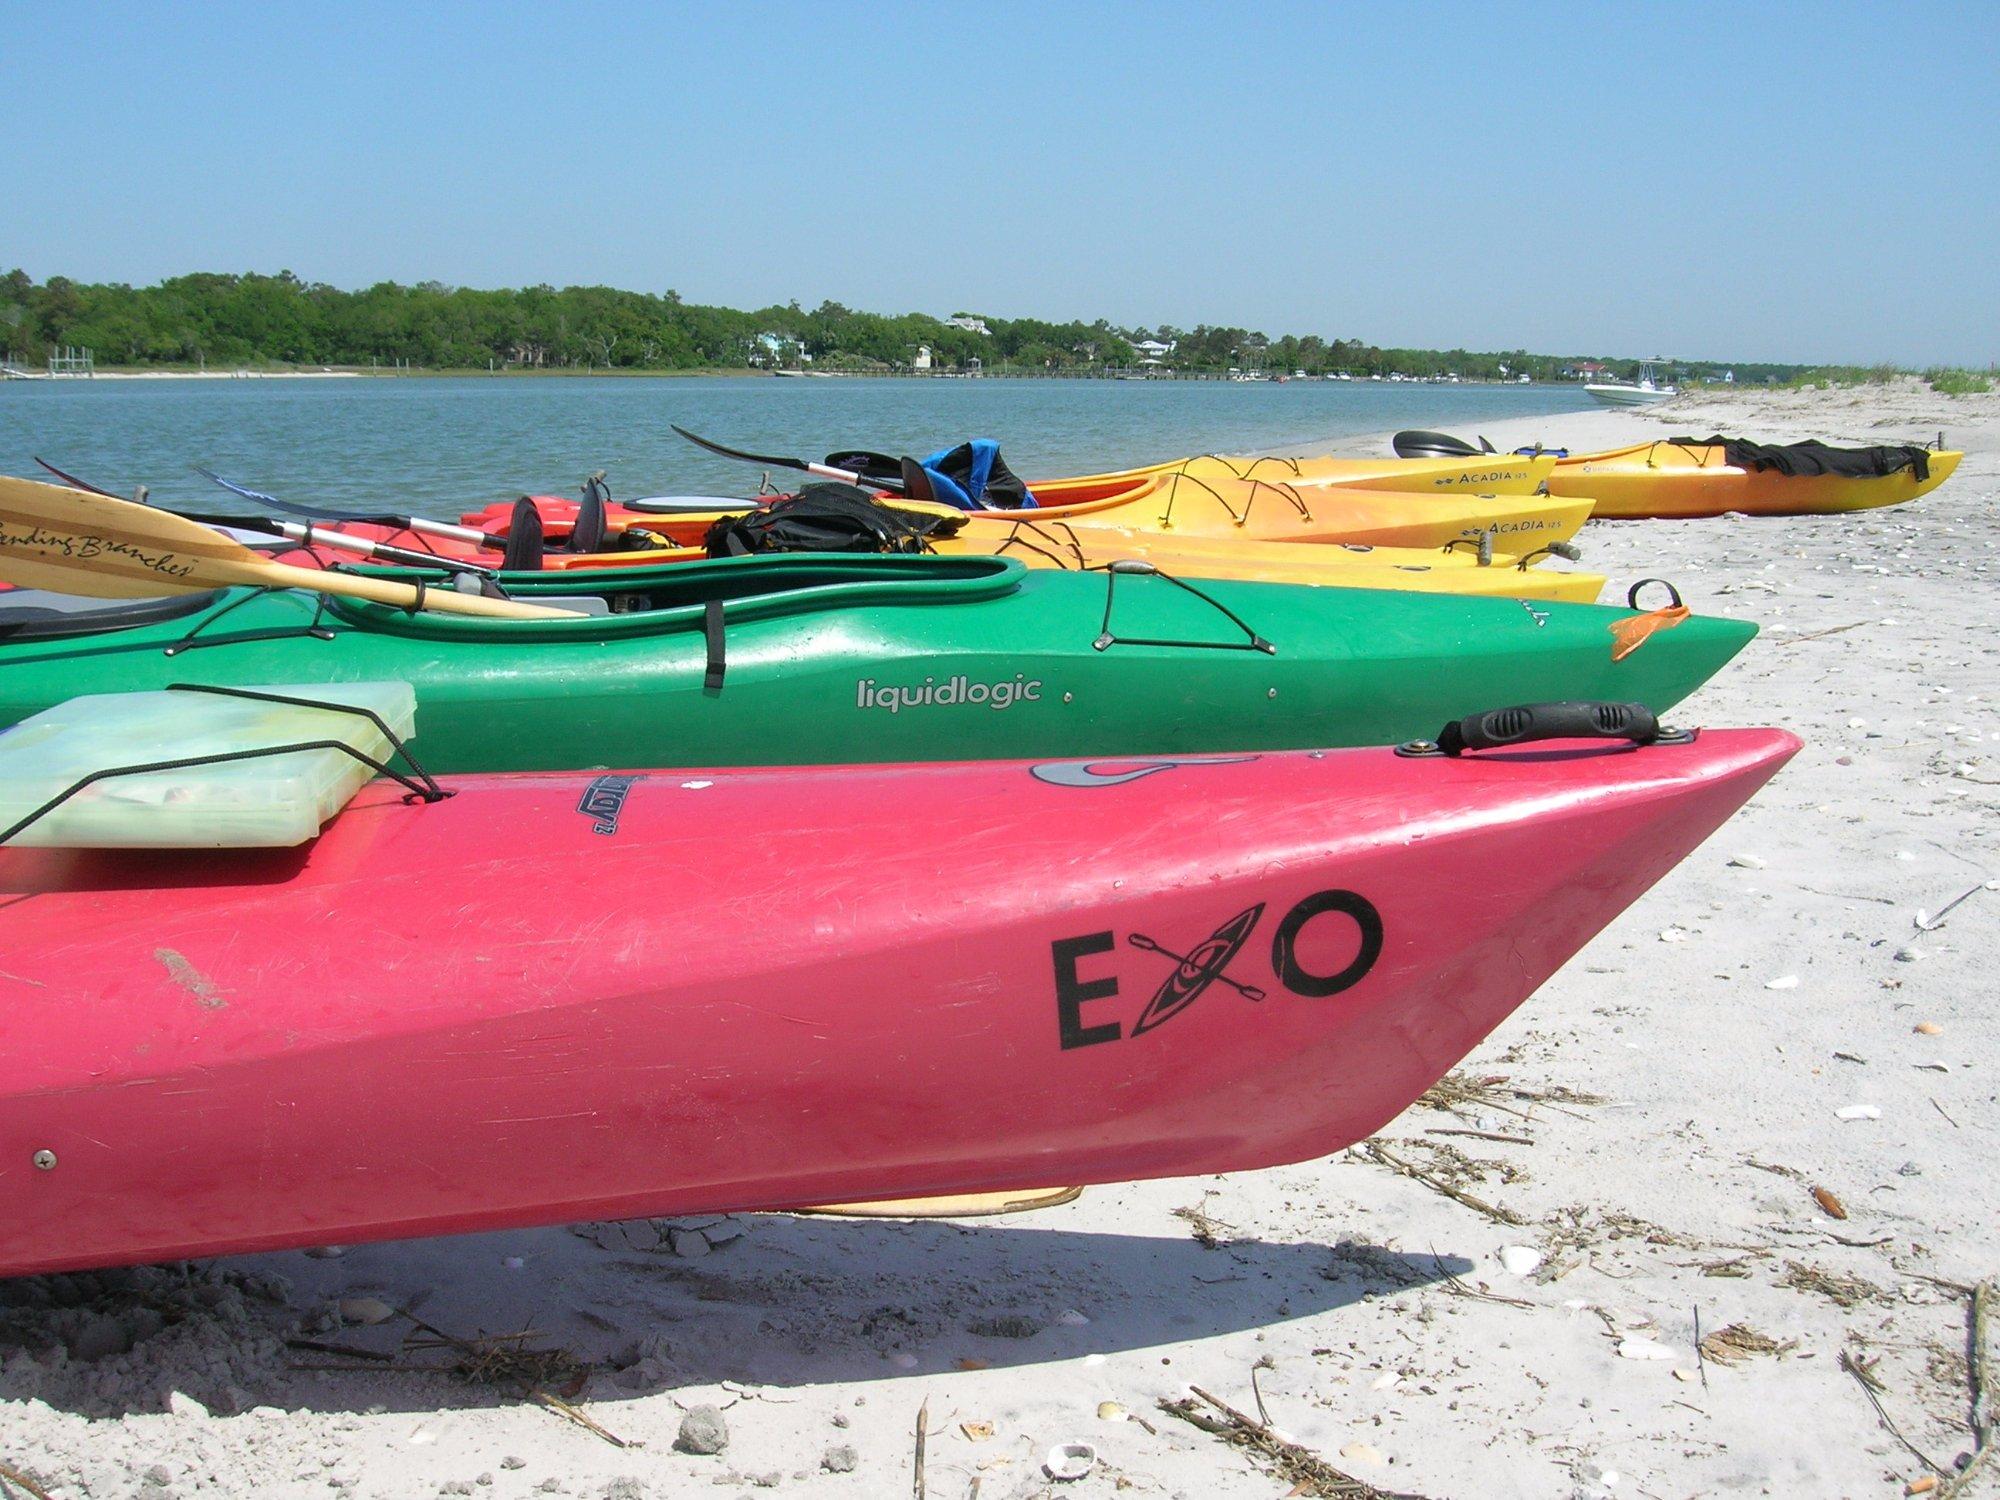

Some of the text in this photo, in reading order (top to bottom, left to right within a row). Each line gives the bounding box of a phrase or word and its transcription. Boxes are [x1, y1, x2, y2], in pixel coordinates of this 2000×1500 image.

[1459, 472, 1512, 484] ACADIA
[1489, 521, 1545, 534] ACADIA
[0, 521, 194, 577] ending Branches
[857, 673, 1042, 714] liquidlogic
[1051, 889, 1384, 1051] EXO
